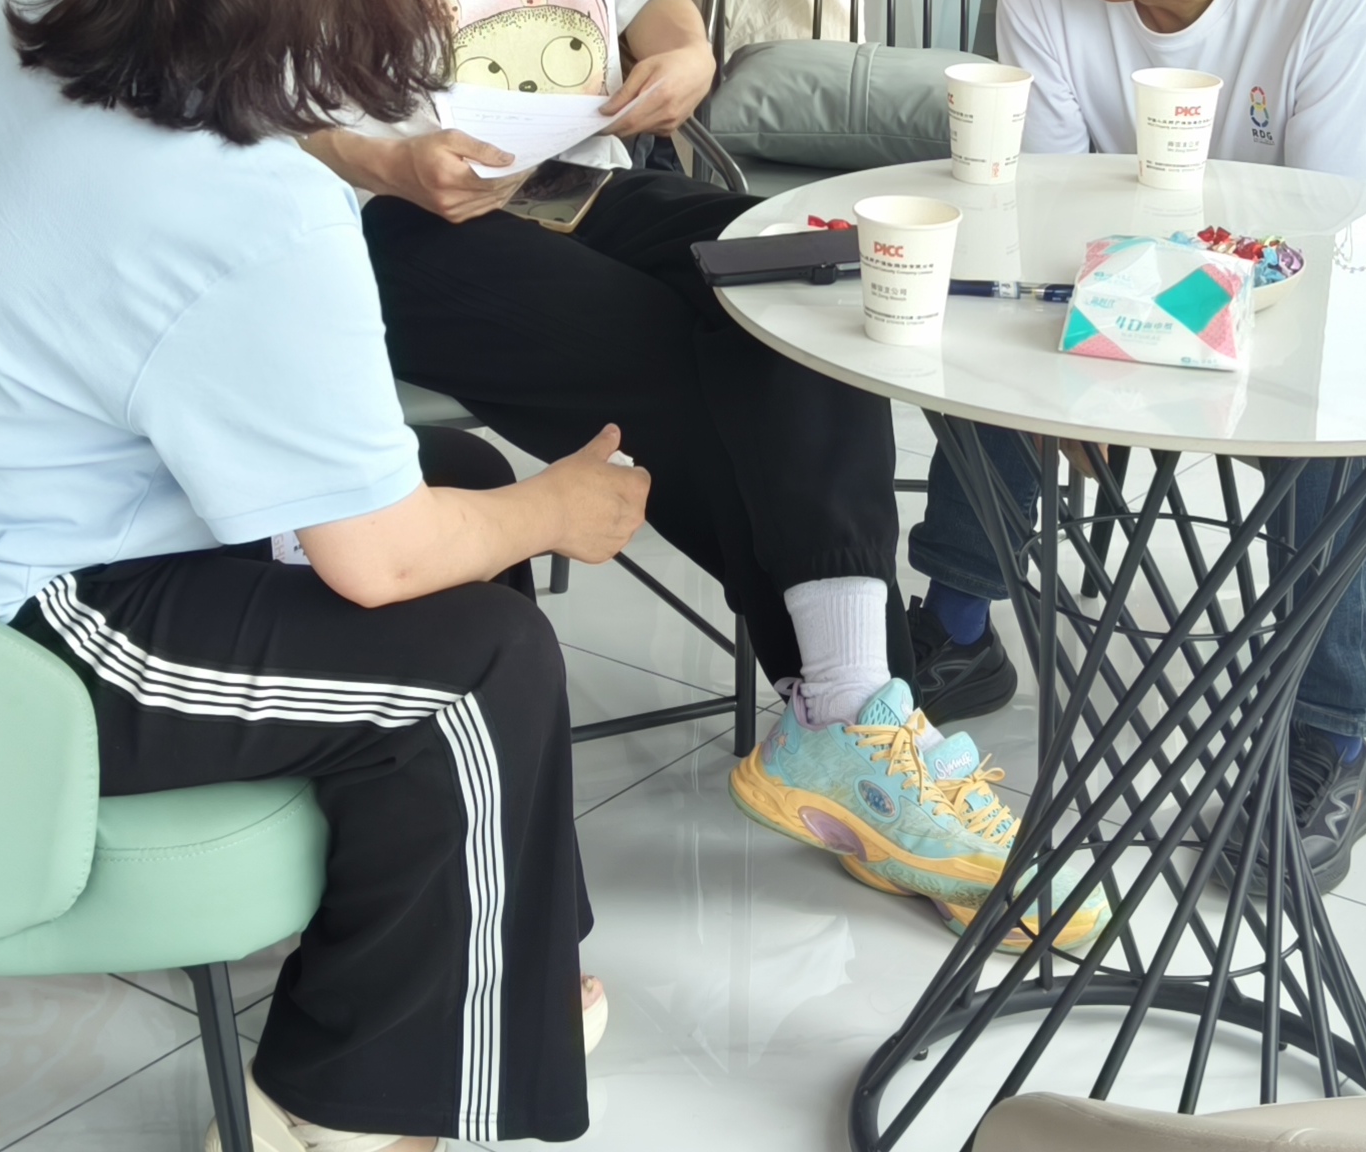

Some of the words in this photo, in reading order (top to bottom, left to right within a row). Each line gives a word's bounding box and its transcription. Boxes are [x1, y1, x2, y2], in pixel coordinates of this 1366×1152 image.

[1173, 105, 1201, 117] PICC
[1251, 128, 1273, 141] RDG
[873, 241, 904, 259] PICC
